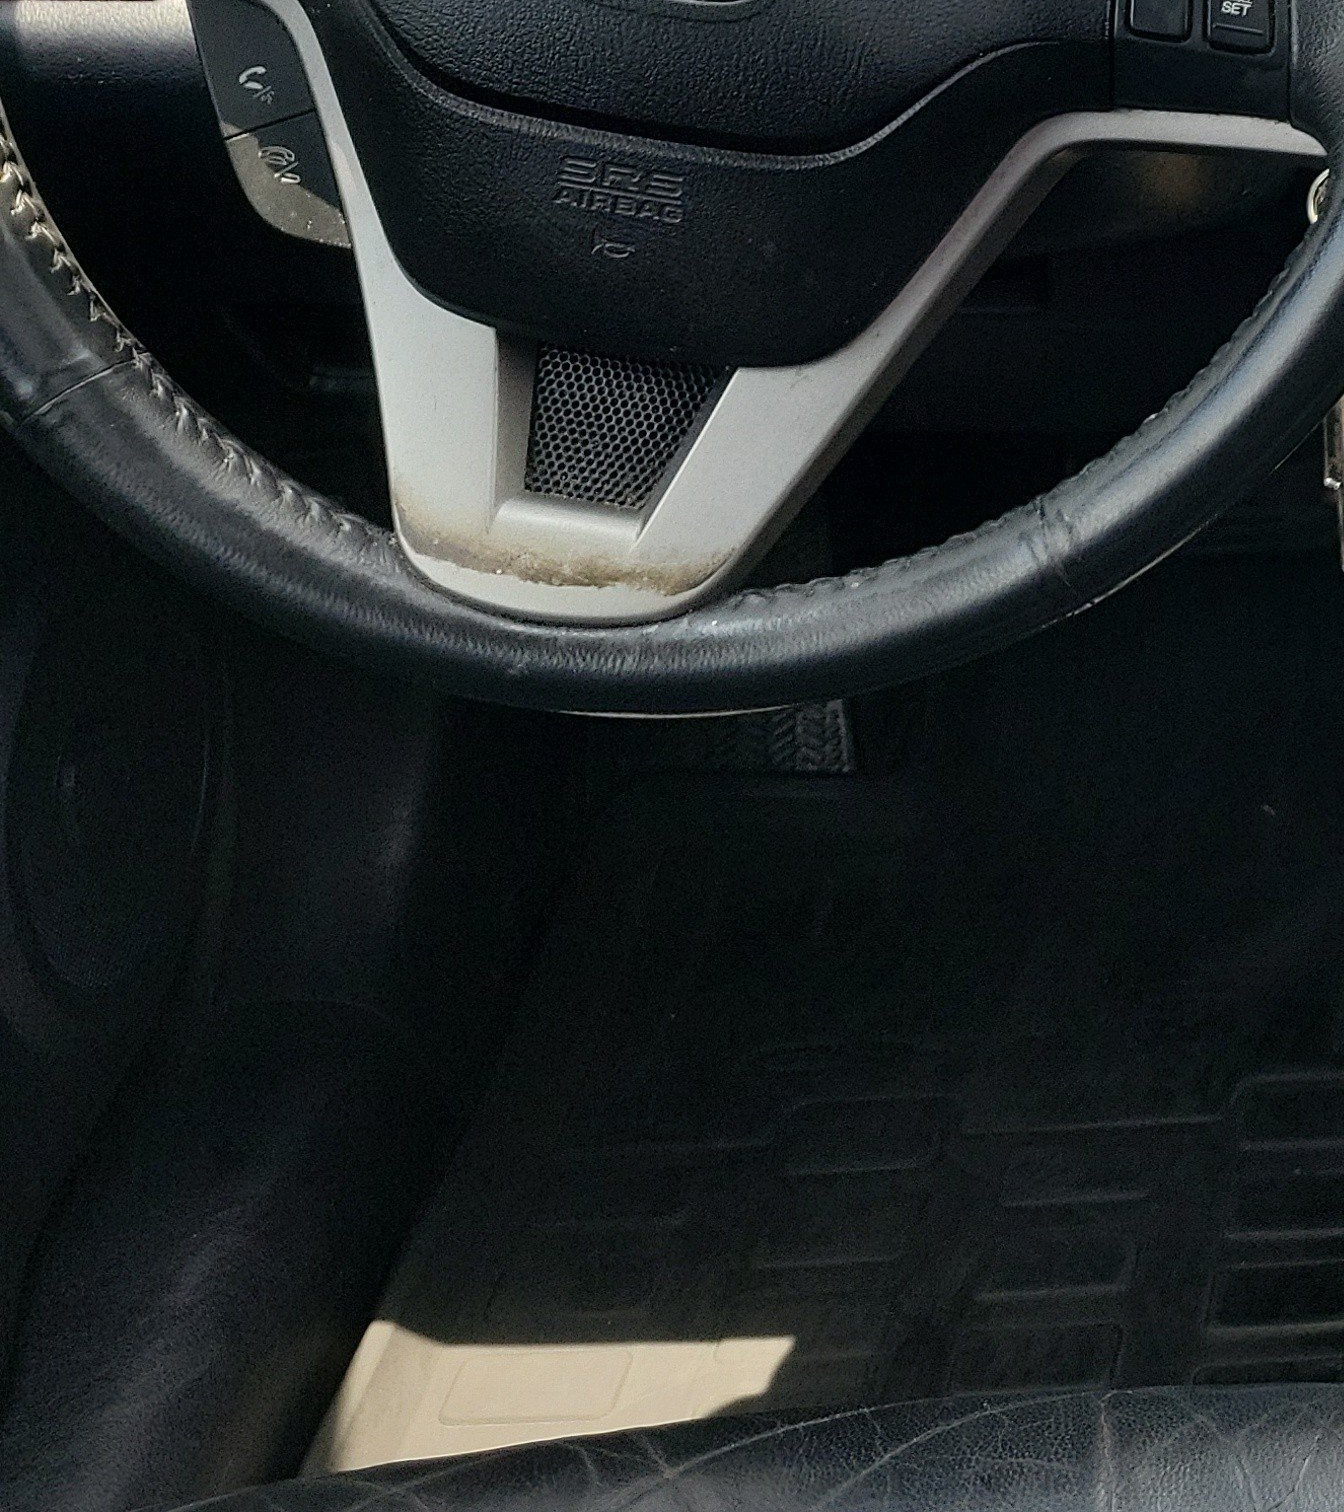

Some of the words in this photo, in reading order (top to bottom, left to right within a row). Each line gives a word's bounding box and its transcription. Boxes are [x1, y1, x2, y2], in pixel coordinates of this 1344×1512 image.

[1221, 2, 1252, 16] SET
[557, 155, 685, 198] SRS
[551, 188, 685, 224] AIRBAG
